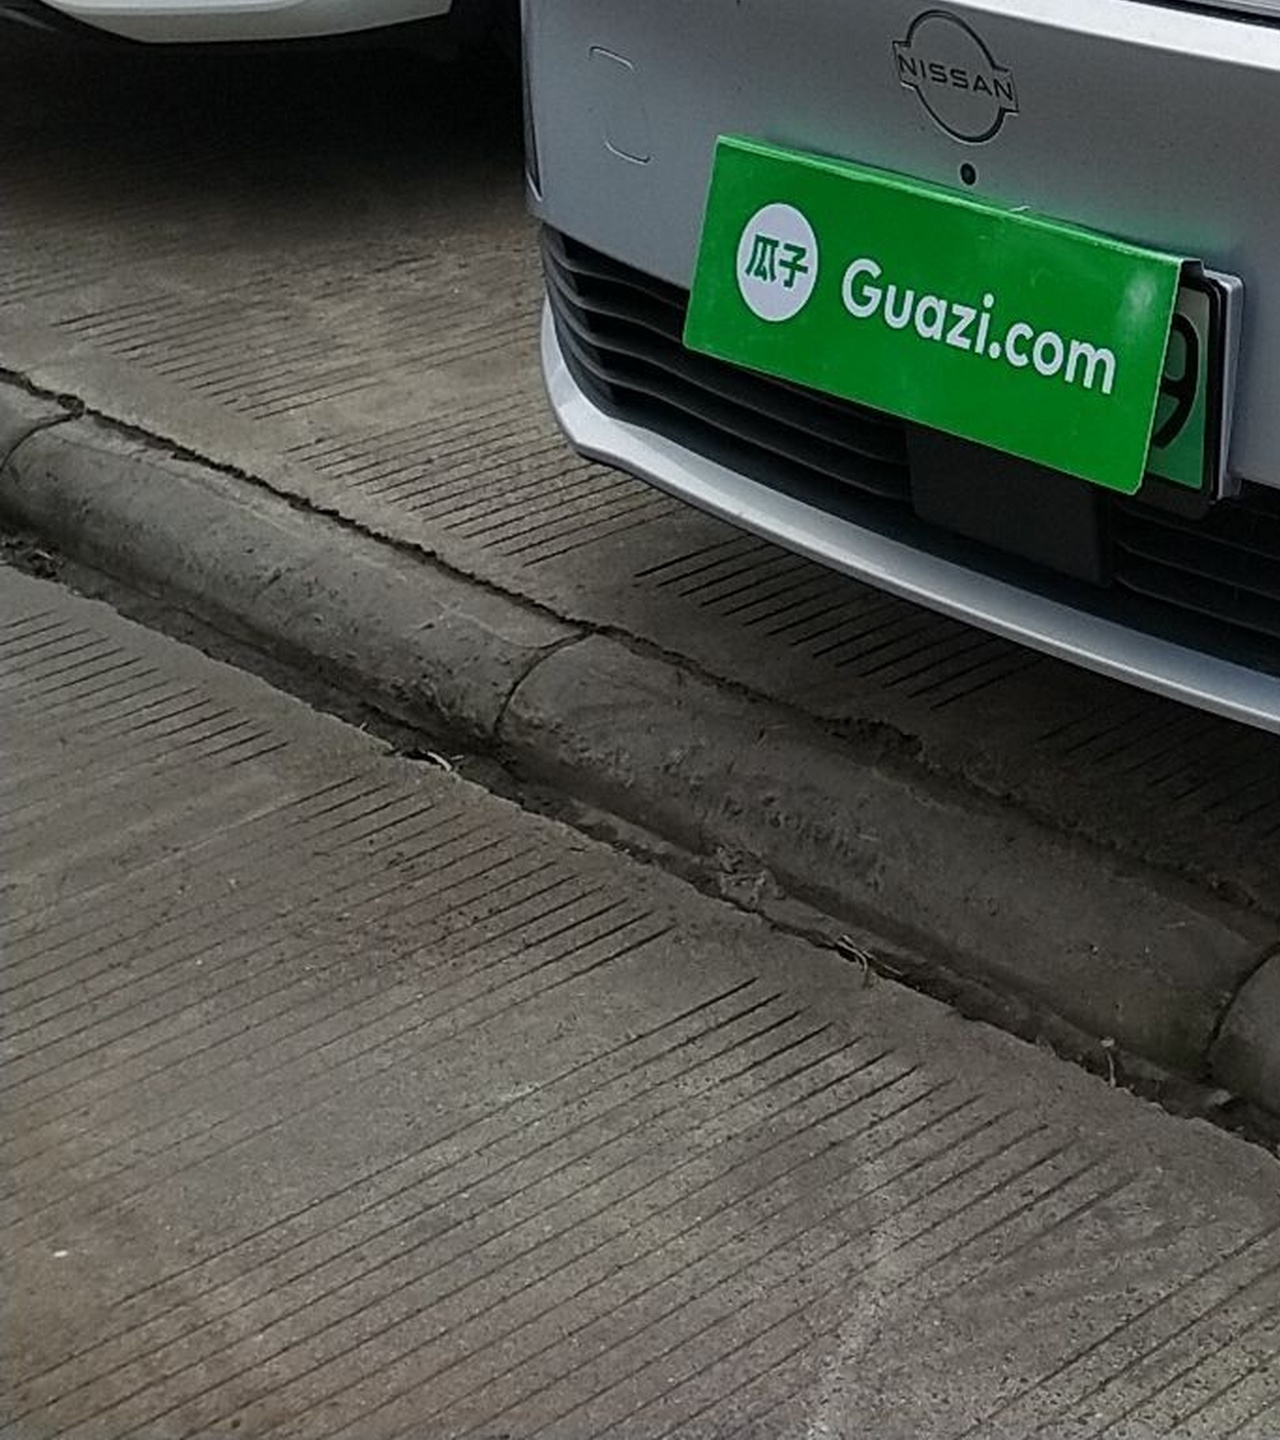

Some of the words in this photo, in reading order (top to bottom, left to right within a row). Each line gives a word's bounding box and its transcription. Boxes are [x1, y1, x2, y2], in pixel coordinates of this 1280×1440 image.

[898, 53, 1014, 102] NISSAN
[744, 232, 809, 290] 瓜子
[841, 258, 1116, 395] Guazi.com
